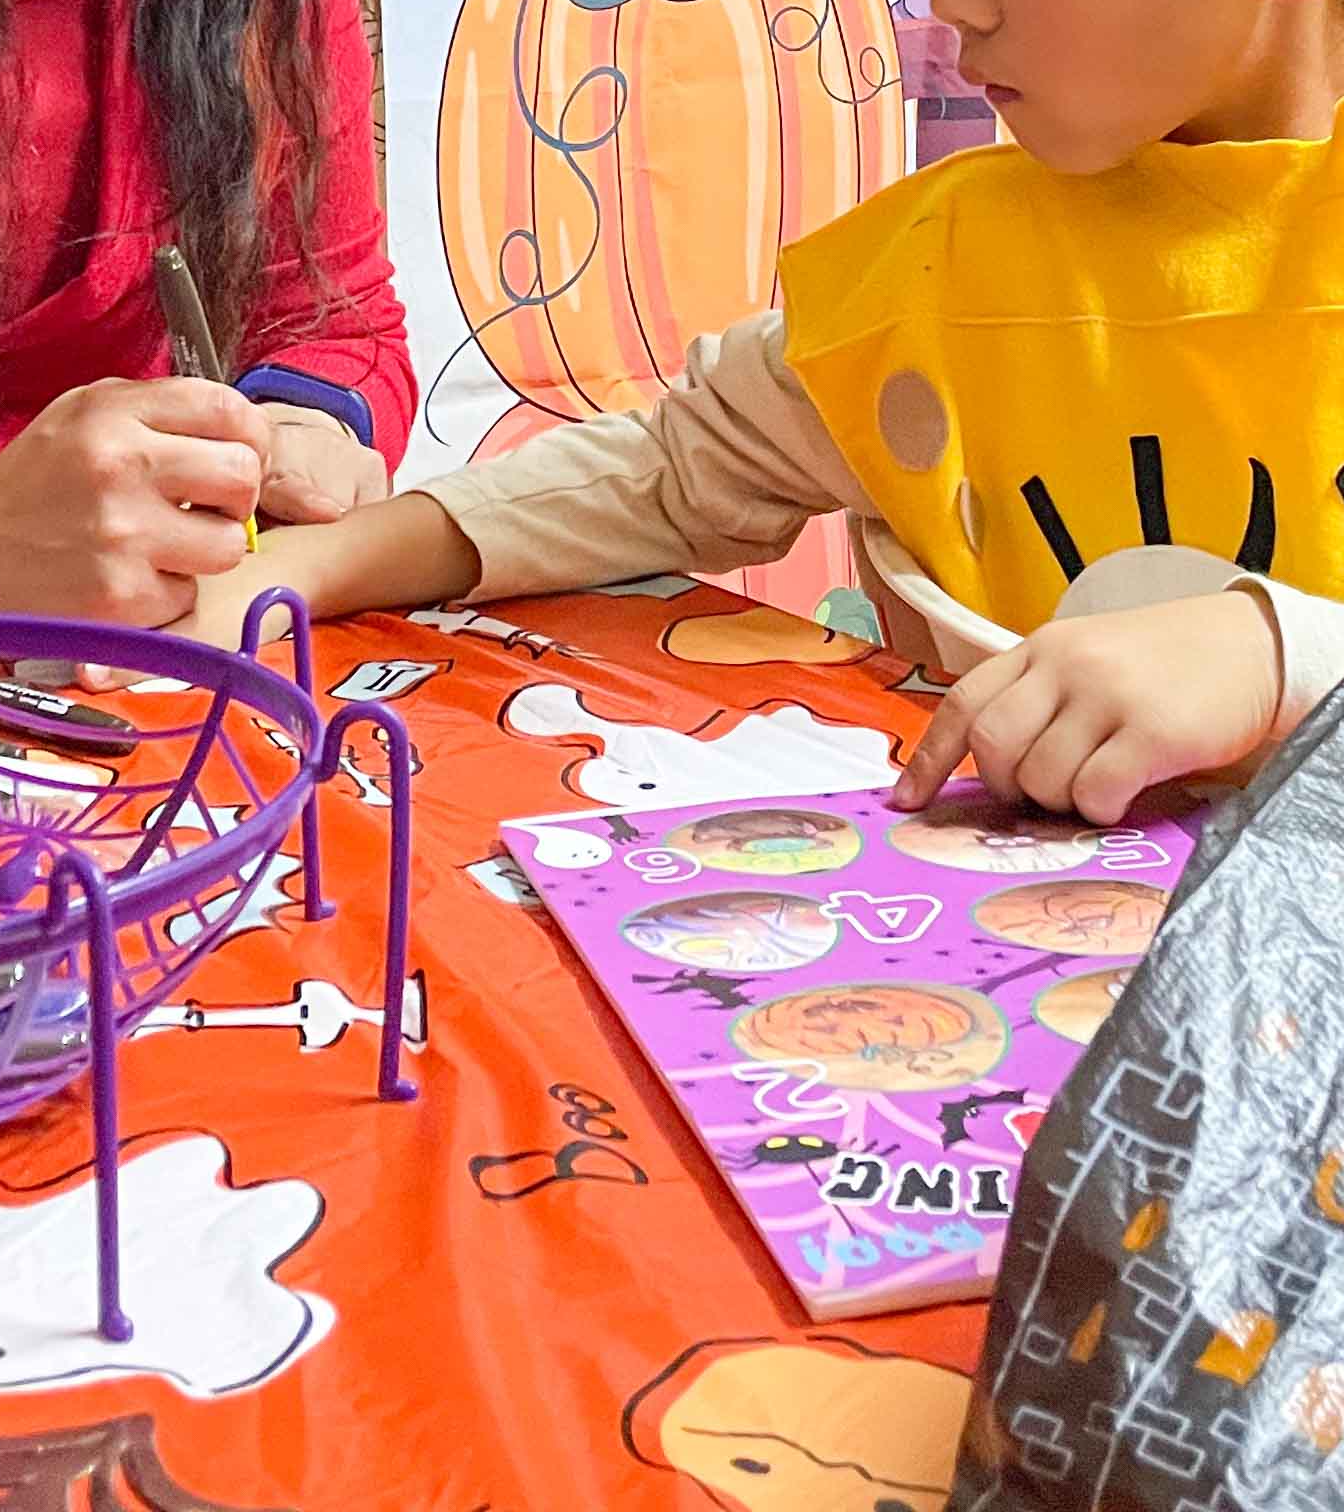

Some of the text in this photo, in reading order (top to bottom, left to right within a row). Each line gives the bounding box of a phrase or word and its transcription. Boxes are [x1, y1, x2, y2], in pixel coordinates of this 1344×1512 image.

[818, 888, 945, 945] 4
[730, 1058, 852, 1121] 2
[822, 1153, 1012, 1215] ING
